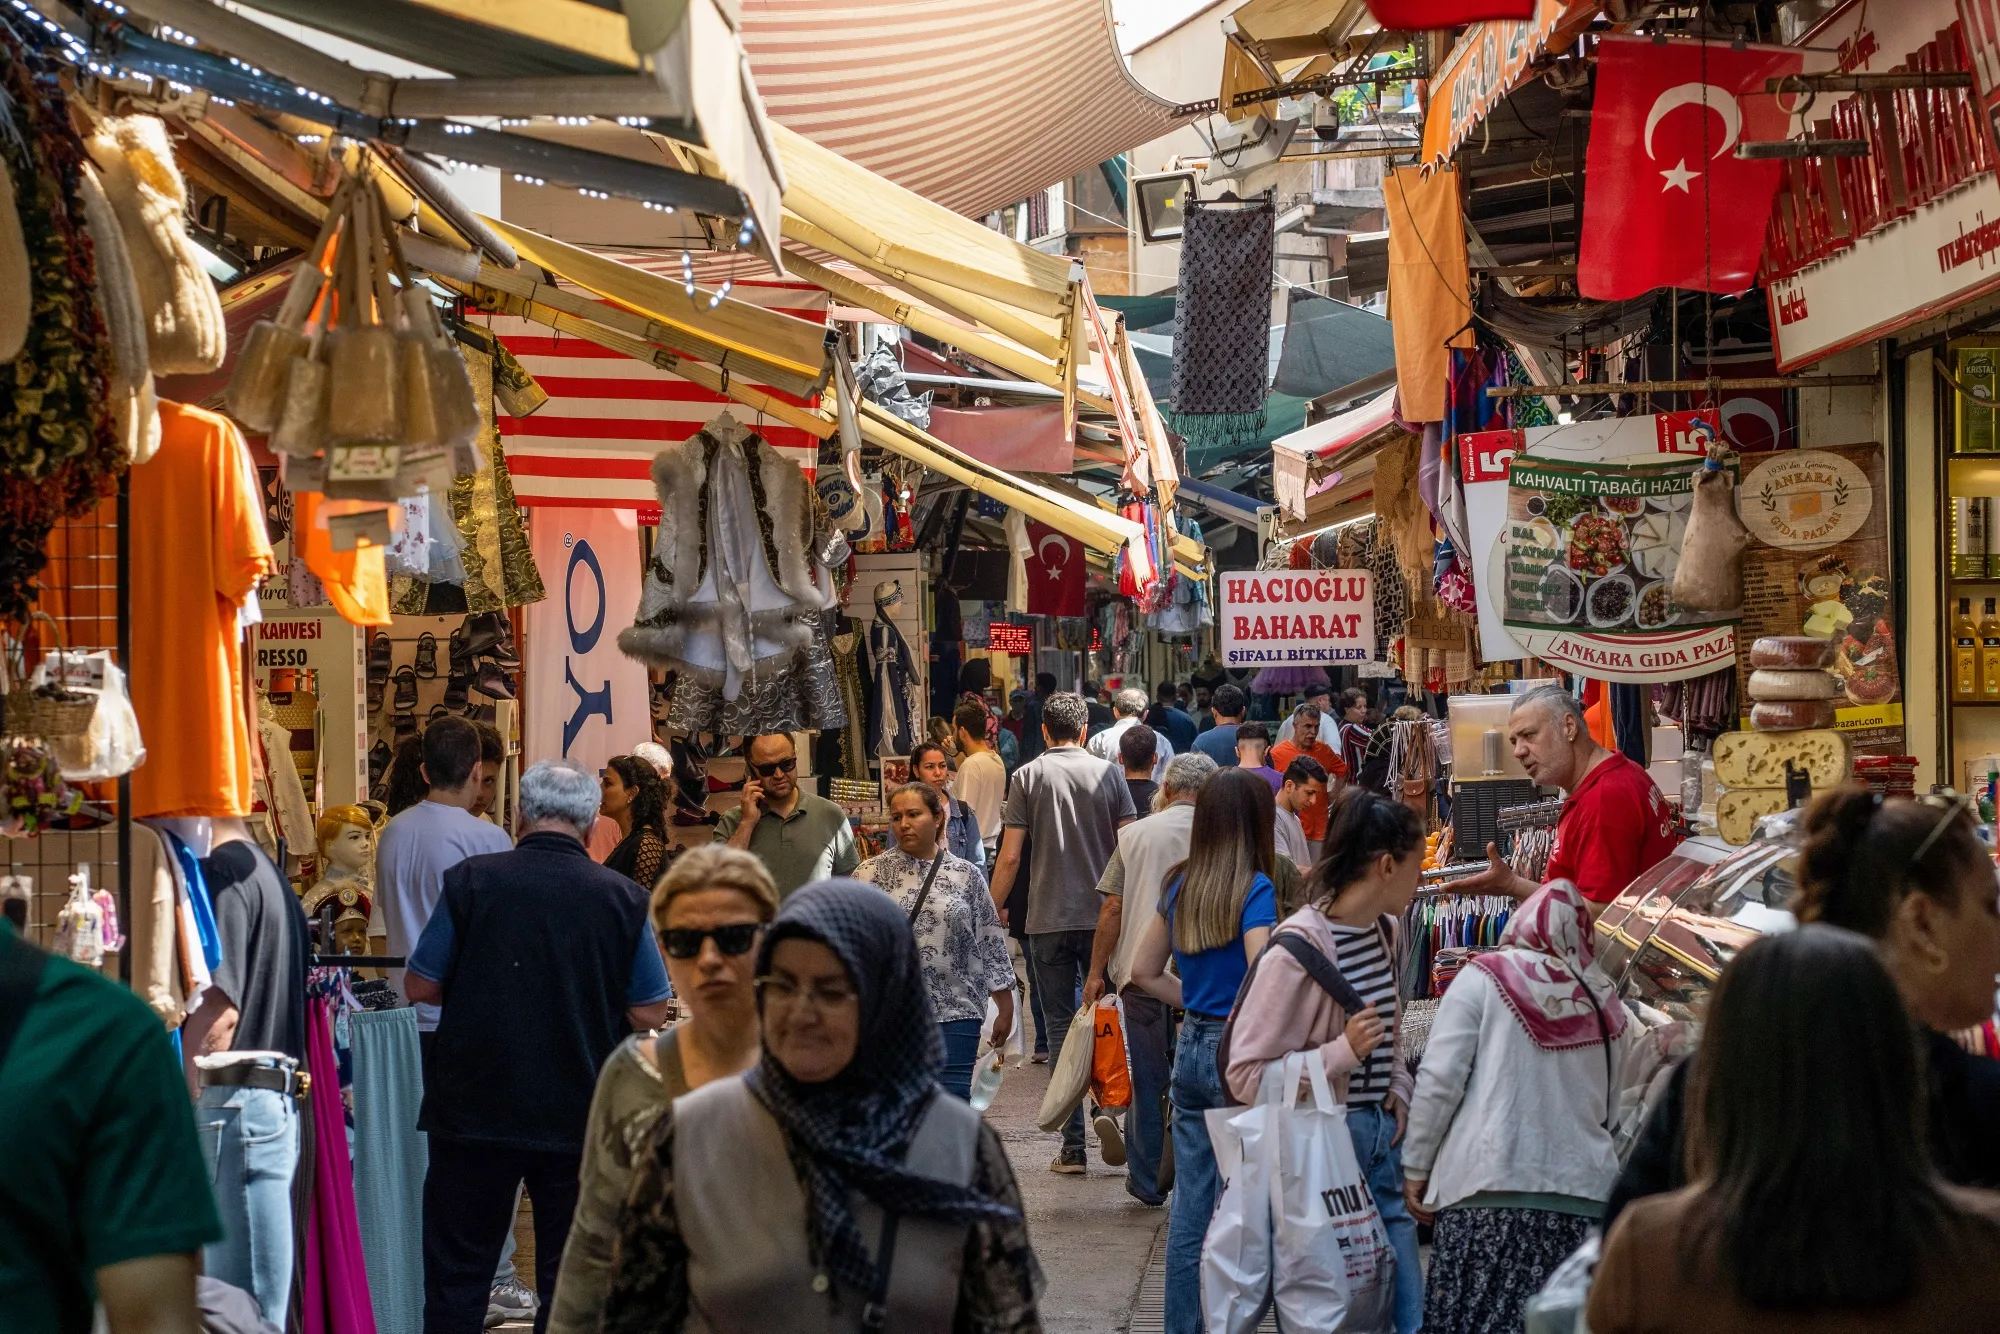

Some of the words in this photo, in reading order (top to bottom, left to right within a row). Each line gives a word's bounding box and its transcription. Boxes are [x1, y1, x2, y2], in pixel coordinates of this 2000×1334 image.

[1966, 365, 1995, 374] KRISTAL
[1480, 448, 1516, 473] 5
[1515, 471, 1586, 493] KAHVALTI
[1590, 478, 1647, 495] TABAĞI
[1775, 471, 1833, 490] ANKARA
[1512, 526, 1535, 539] BAL
[1770, 515, 1797, 539] GIDA
[1802, 511, 1842, 540] PAZARI
[1512, 544, 1565, 560] KAYMAK
[1511, 560, 1549, 577] TAHİN
[1227, 571, 1366, 603] HACIOĞLU
[1511, 579, 1562, 596] PEKMEZ
[259, 618, 322, 640] KAHVESİ
[1233, 614, 1362, 640] BAHARAT
[257, 648, 308, 667] RESSO
[1228, 648, 1283, 664] ŞİFALI
[1287, 646, 1367, 662] BİTKİLER
[1556, 638, 1634, 668] ANKARA
[1639, 645, 1688, 668] GIDA
[1832, 717, 1883, 729] pazari.com
